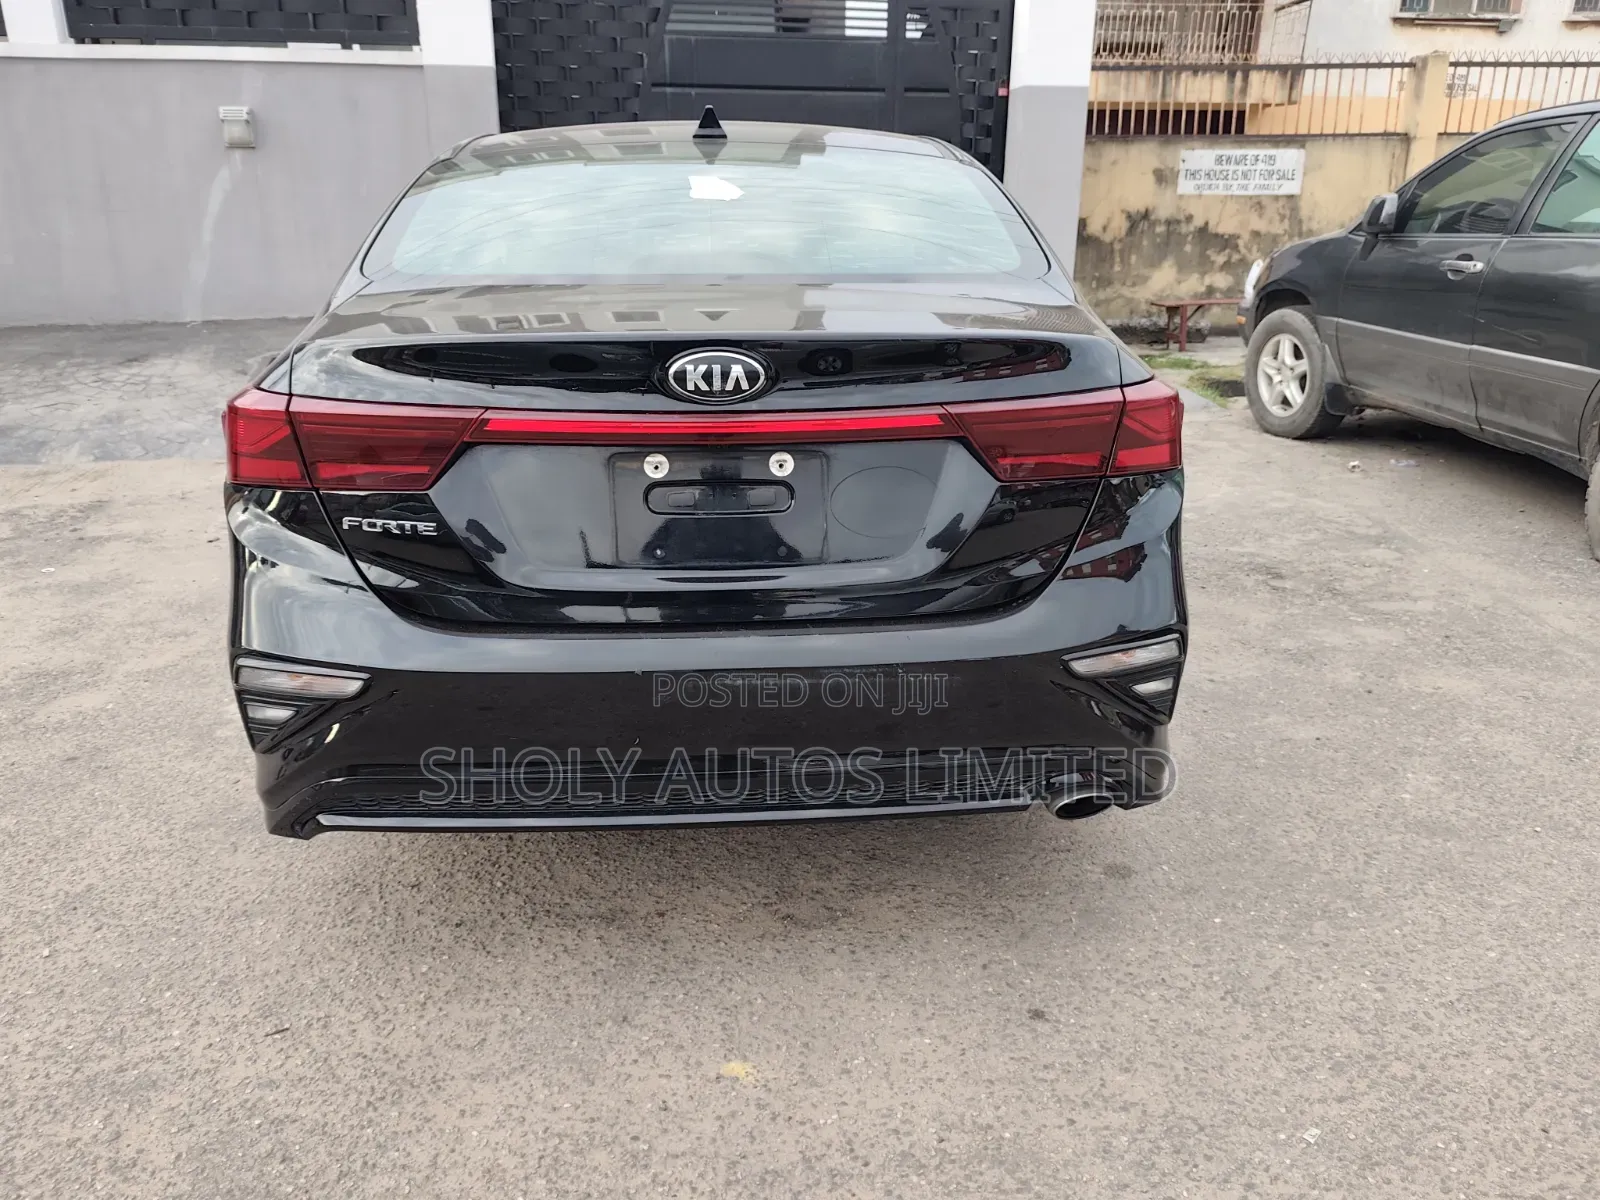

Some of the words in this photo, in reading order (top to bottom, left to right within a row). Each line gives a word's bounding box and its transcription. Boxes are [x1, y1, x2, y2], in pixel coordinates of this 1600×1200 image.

[1214, 153, 1249, 167] BEWARE
[1249, 153, 1260, 167] OF
[1261, 153, 1277, 167] 419
[1184, 168, 1203, 181] THIS
[1204, 168, 1230, 181] HOUSE
[1231, 168, 1240, 181] IS
[1240, 168, 1259, 181] NOT
[1260, 168, 1275, 181] FOR
[1275, 168, 1296, 181] SALE
[685, 364, 750, 391] KIA
[342, 516, 438, 536] FORTE
